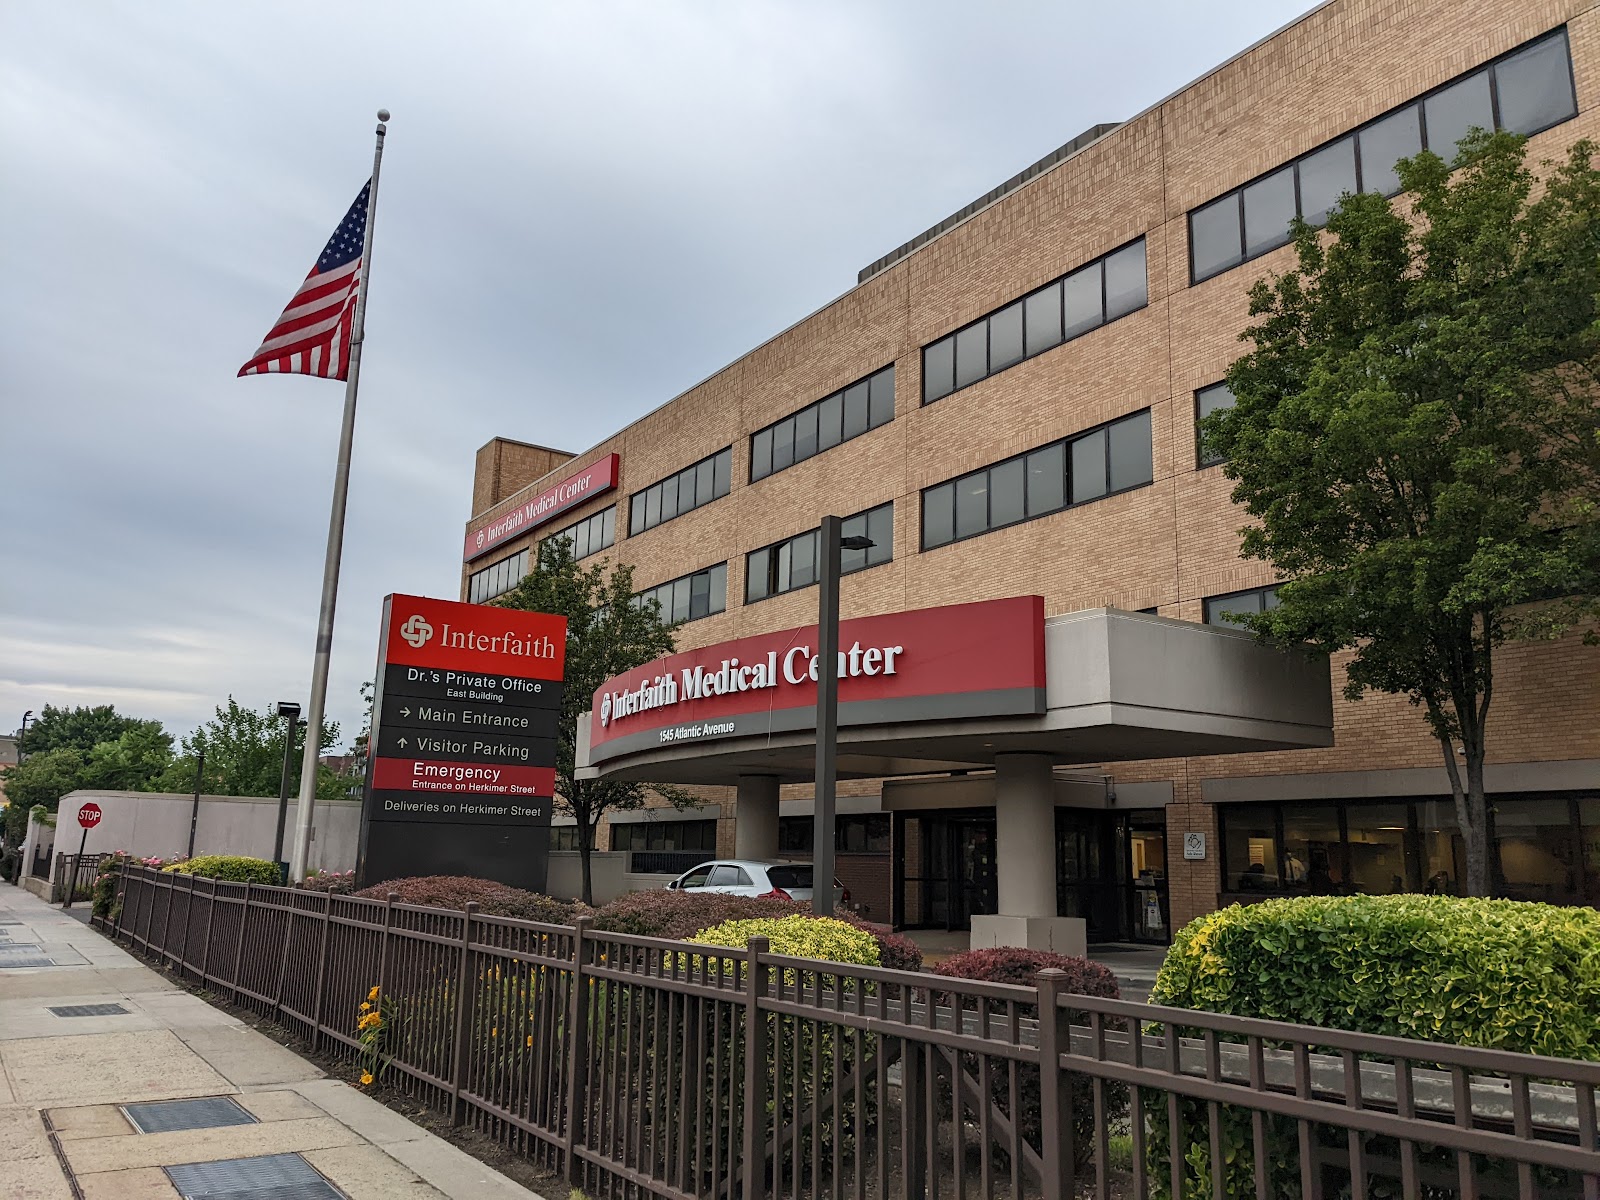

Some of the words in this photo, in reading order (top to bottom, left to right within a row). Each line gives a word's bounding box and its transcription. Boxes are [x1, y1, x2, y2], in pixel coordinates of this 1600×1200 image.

[487, 510, 523, 542] Interfaith
[525, 489, 558, 522] Medical
[559, 474, 592, 503] Center
[440, 623, 556, 659] Interfaith
[407, 668, 440, 684] Dr.'s
[446, 672, 496, 689] Private
[501, 678, 542, 693] Office
[611, 672, 678, 721] Interfaith
[680, 651, 778, 702] Medical
[447, 688, 467, 699] East
[469, 690, 504, 703] Building
[418, 707, 456, 723] Main
[462, 710, 529, 728] Entrance
[659, 729, 674, 742] 1545
[675, 726, 702, 740] Atlantic
[702, 721, 735, 736] Avenue
[417, 737, 468, 754] Visitor
[473, 741, 529, 761] Parking
[413, 762, 501, 783] Emergency
[412, 779, 453, 790] Entrance
[455, 783, 466, 791] on
[468, 782, 508, 793] Herkimer
[510, 784, 536, 794] Street
[79, 809, 100, 821] STOP
[384, 800, 439, 813] Deliveries
[442, 803, 456, 813] on
[459, 803, 508, 816] Herkimer
[510, 806, 542, 817] Street
